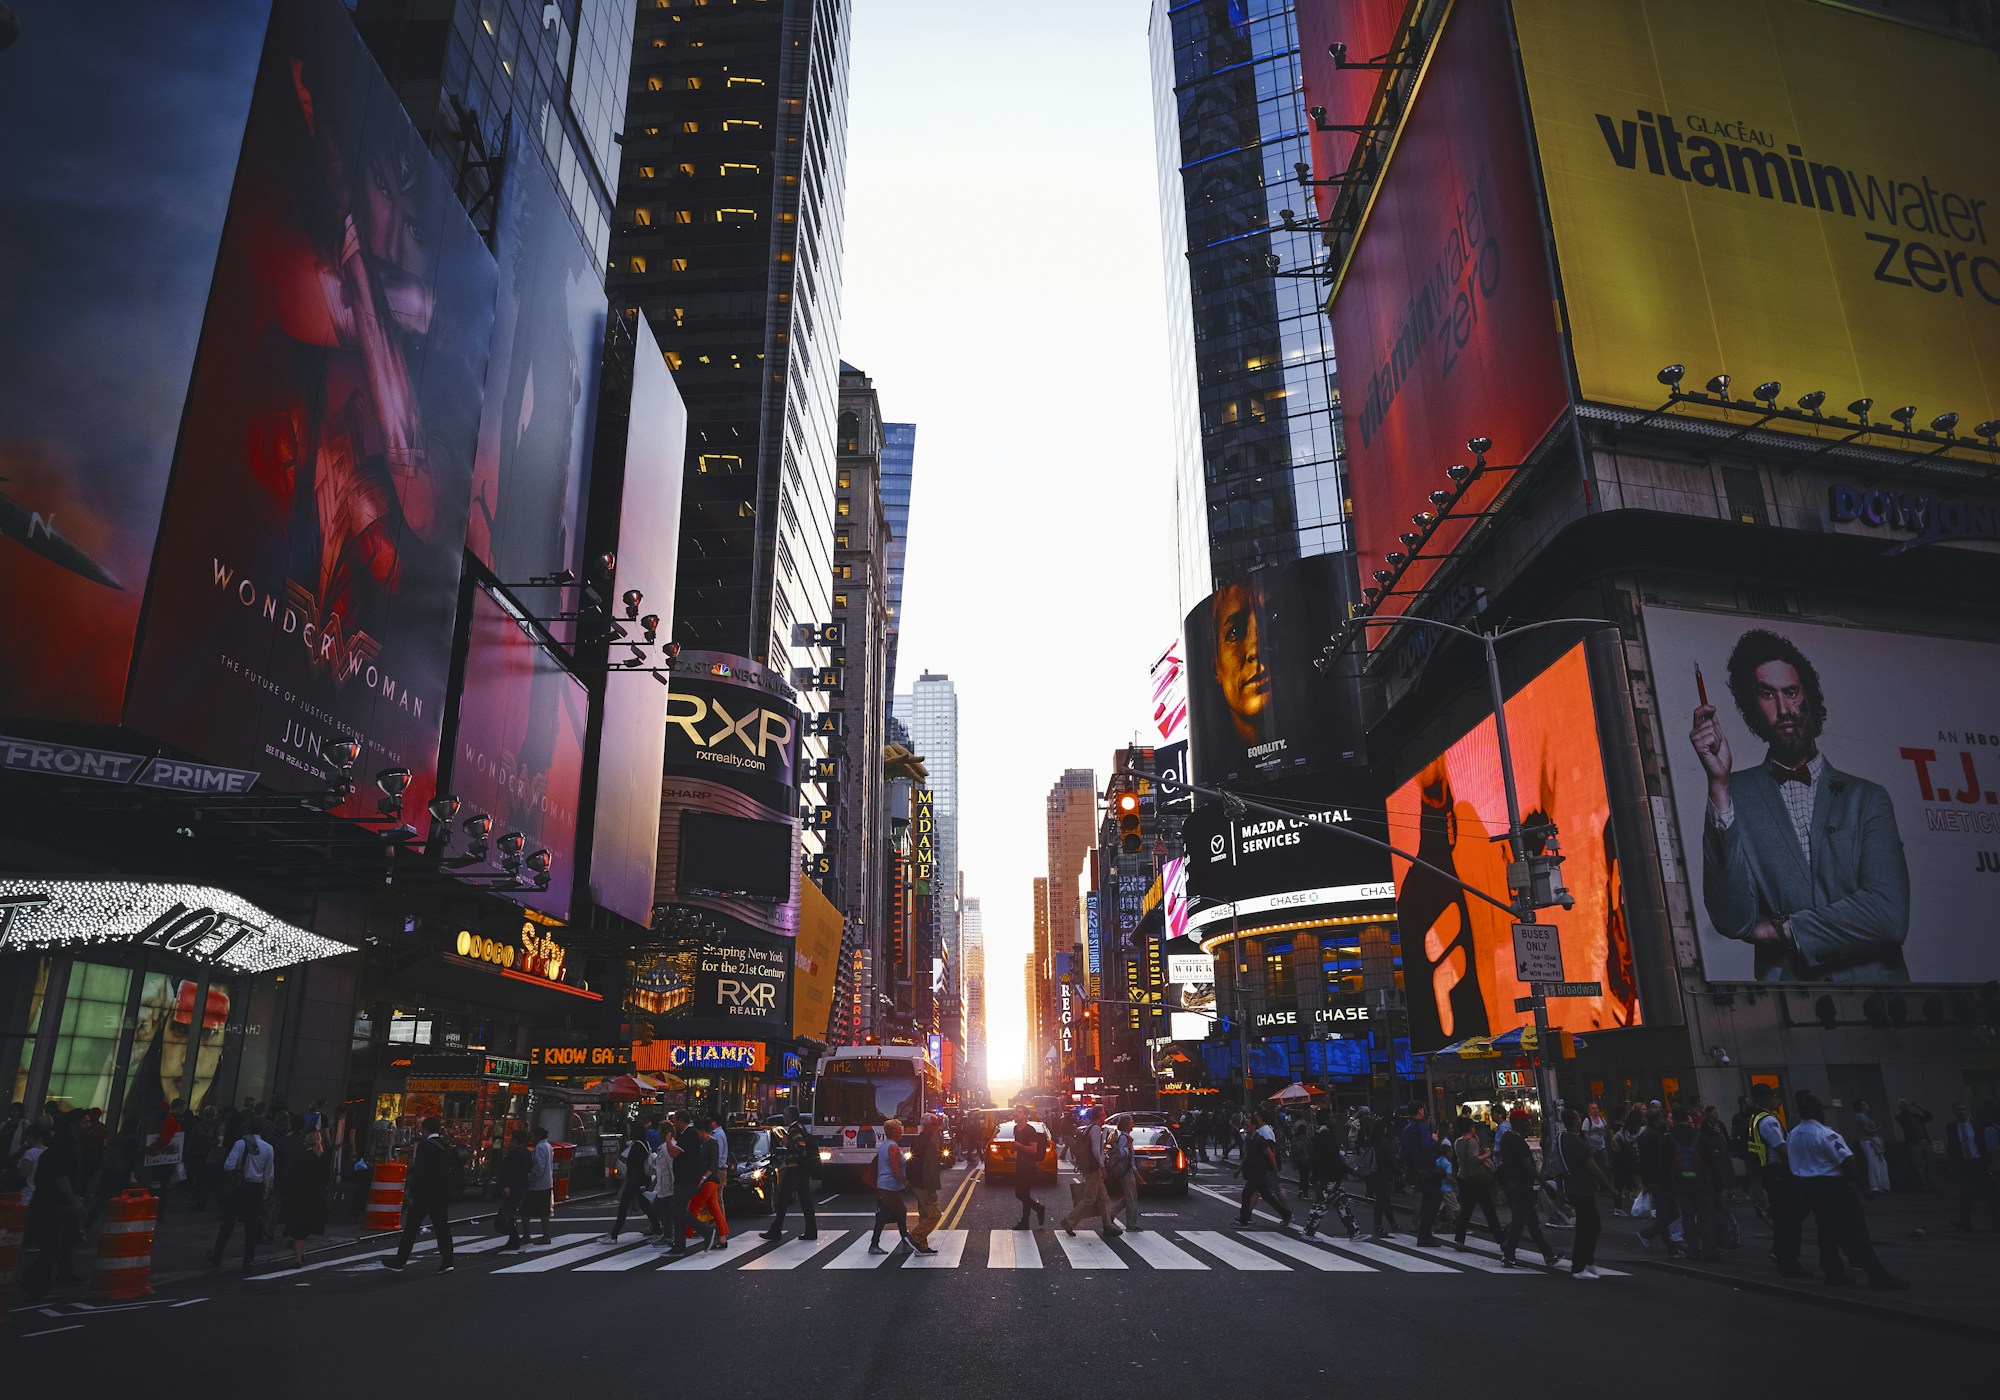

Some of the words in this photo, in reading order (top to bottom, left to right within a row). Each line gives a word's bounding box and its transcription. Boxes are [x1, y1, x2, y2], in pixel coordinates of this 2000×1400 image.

[1686, 114, 1775, 148] GLACÉAU
[1595, 109, 1987, 246] vitaminwater
[1864, 231, 2000, 306] zero
[1438, 236, 1501, 379] zero
[1828, 483, 1928, 533] DOW
[212, 556, 336, 660] WONDER
[348, 650, 424, 720] WOMAN
[220, 654, 240, 674] THE
[244, 667, 280, 697] FUTURE
[284, 691, 296, 704] OF
[300, 698, 333, 727] JUSTICE
[337, 720, 365, 743] BEGINS
[281, 719, 322, 758] JUN
[666, 691, 791, 768] RXR
[1938, 731, 1958, 744] AN
[1964, 732, 2000, 747] HBO
[695, 749, 767, 772] rxrrealty.com
[819, 626, 838, 874] CHAMPS
[1247, 738, 1288, 759] EQUALITY.
[152, 763, 246, 793] PRIME
[465, 743, 524, 799] WONDER
[531, 789, 574, 828] WOMAN
[1899, 747, 1999, 805] T.J.
[661, 789, 713, 800] SHARP
[917, 790, 933, 878] MADAME
[1242, 818, 1286, 839] MAZDA
[1242, 831, 1301, 854] SERVICES
[1209, 906, 1234, 920] CHASE
[1269, 893, 1307, 907] CHASE
[143, 912, 265, 963] LOFT
[1521, 929, 1550, 940] BUSES
[1526, 941, 1547, 951] ONLY
[748, 947, 768, 961] New
[769, 949, 784, 964] York
[1089, 939, 1101, 974] STUDIOS
[1148, 937, 1161, 986] VICTORY
[1175, 964, 1213, 973] WORK
[701, 959, 719, 972] for
[721, 960, 738, 974] the
[738, 962, 757, 976] 21st
[758, 964, 786, 983] Century
[717, 978, 777, 1009] RXR
[1090, 976, 1101, 998] DUKE
[1556, 983, 1601, 996] Broadway
[729, 1005, 767, 1017] REALTY
[1060, 984, 1072, 1052] REGAL
[1256, 1011, 1298, 1027] CHASE
[1314, 1007, 1370, 1023] CHASE
[544, 1047, 588, 1066] KNOW
[669, 1045, 756, 1067] CHAMPS
[1497, 1070, 1526, 1087] SODA
